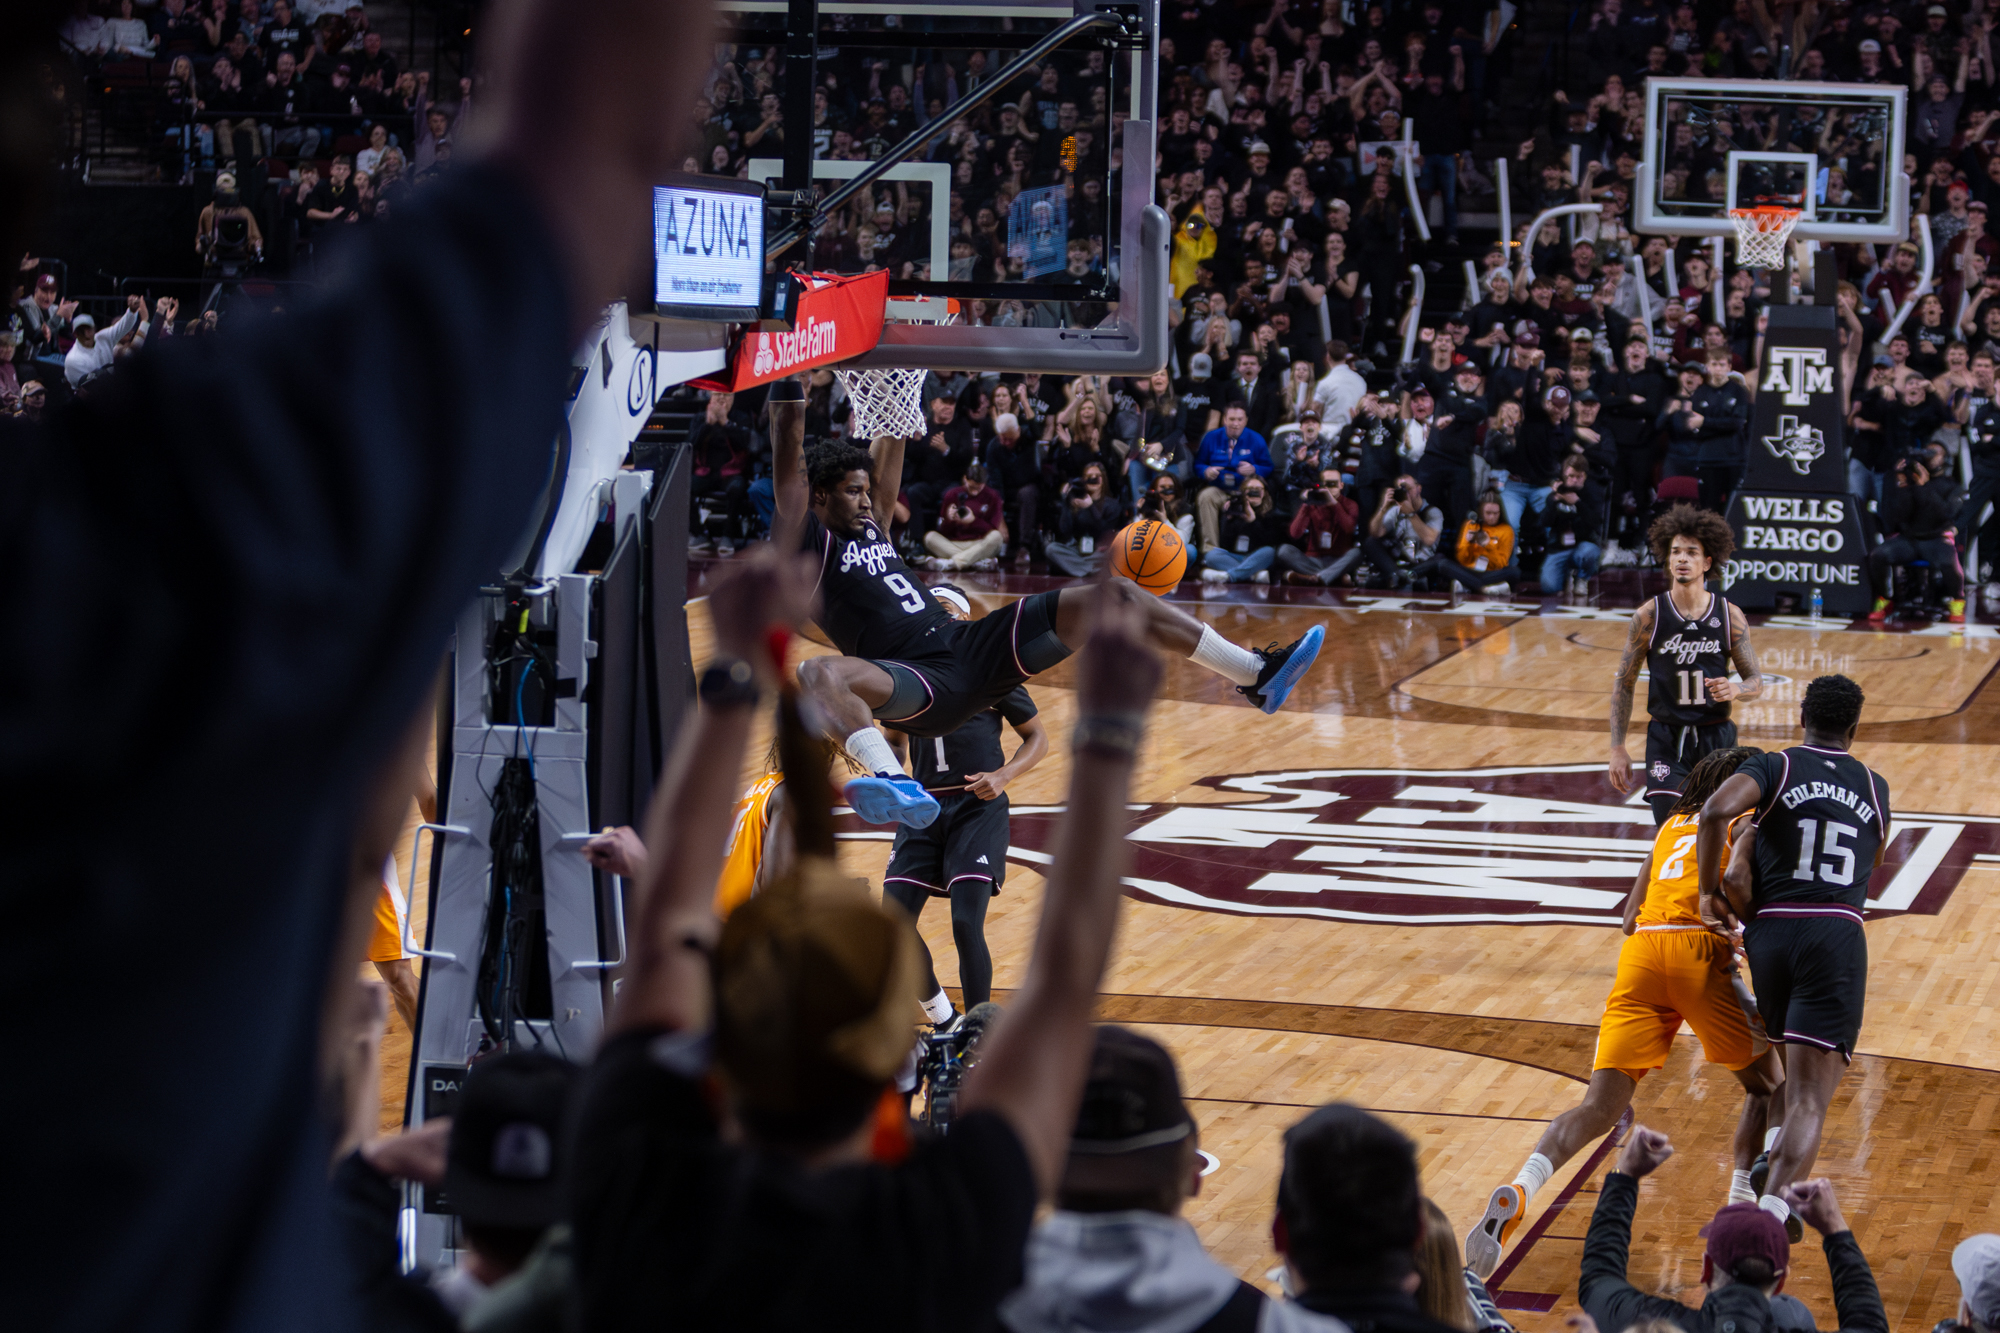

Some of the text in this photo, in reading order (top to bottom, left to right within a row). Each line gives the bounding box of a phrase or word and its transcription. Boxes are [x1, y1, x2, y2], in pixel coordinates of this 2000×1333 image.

[664, 196, 751, 260] AZUNA
[1742, 496, 1845, 524] WELLS
[1130, 518, 1155, 552] Wilso
[1742, 526, 1845, 553] FARGO
[840, 540, 897, 576] Aggies
[883, 572, 926, 614] 9
[1660, 633, 1722, 665] Aggies
[1676, 670, 1707, 706] 11
[1781, 781, 1876, 824] COLEMAN III
[1658, 834, 1697, 881] 2
[1793, 818, 1858, 886] 15
